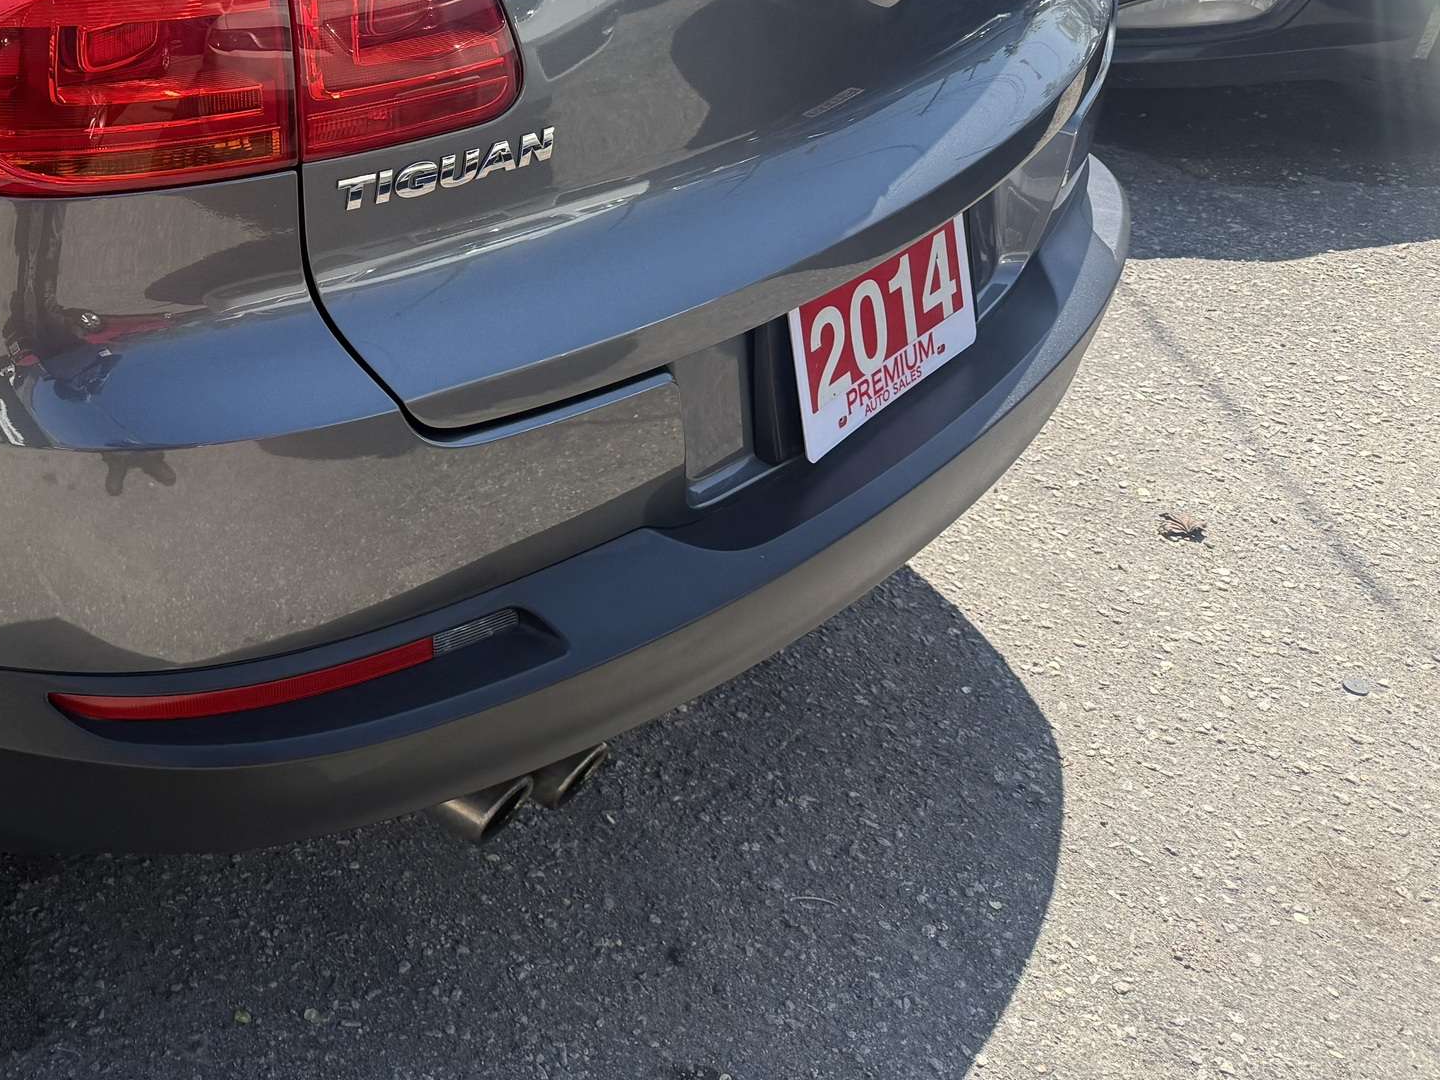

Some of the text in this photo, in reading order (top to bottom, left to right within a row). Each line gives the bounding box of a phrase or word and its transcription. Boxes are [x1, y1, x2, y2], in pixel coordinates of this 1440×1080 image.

[336, 125, 556, 212] TIGUAN
[810, 229, 958, 408] 2014
[846, 331, 935, 415] PREMIUM
[864, 365, 922, 417] AUTO SALES
